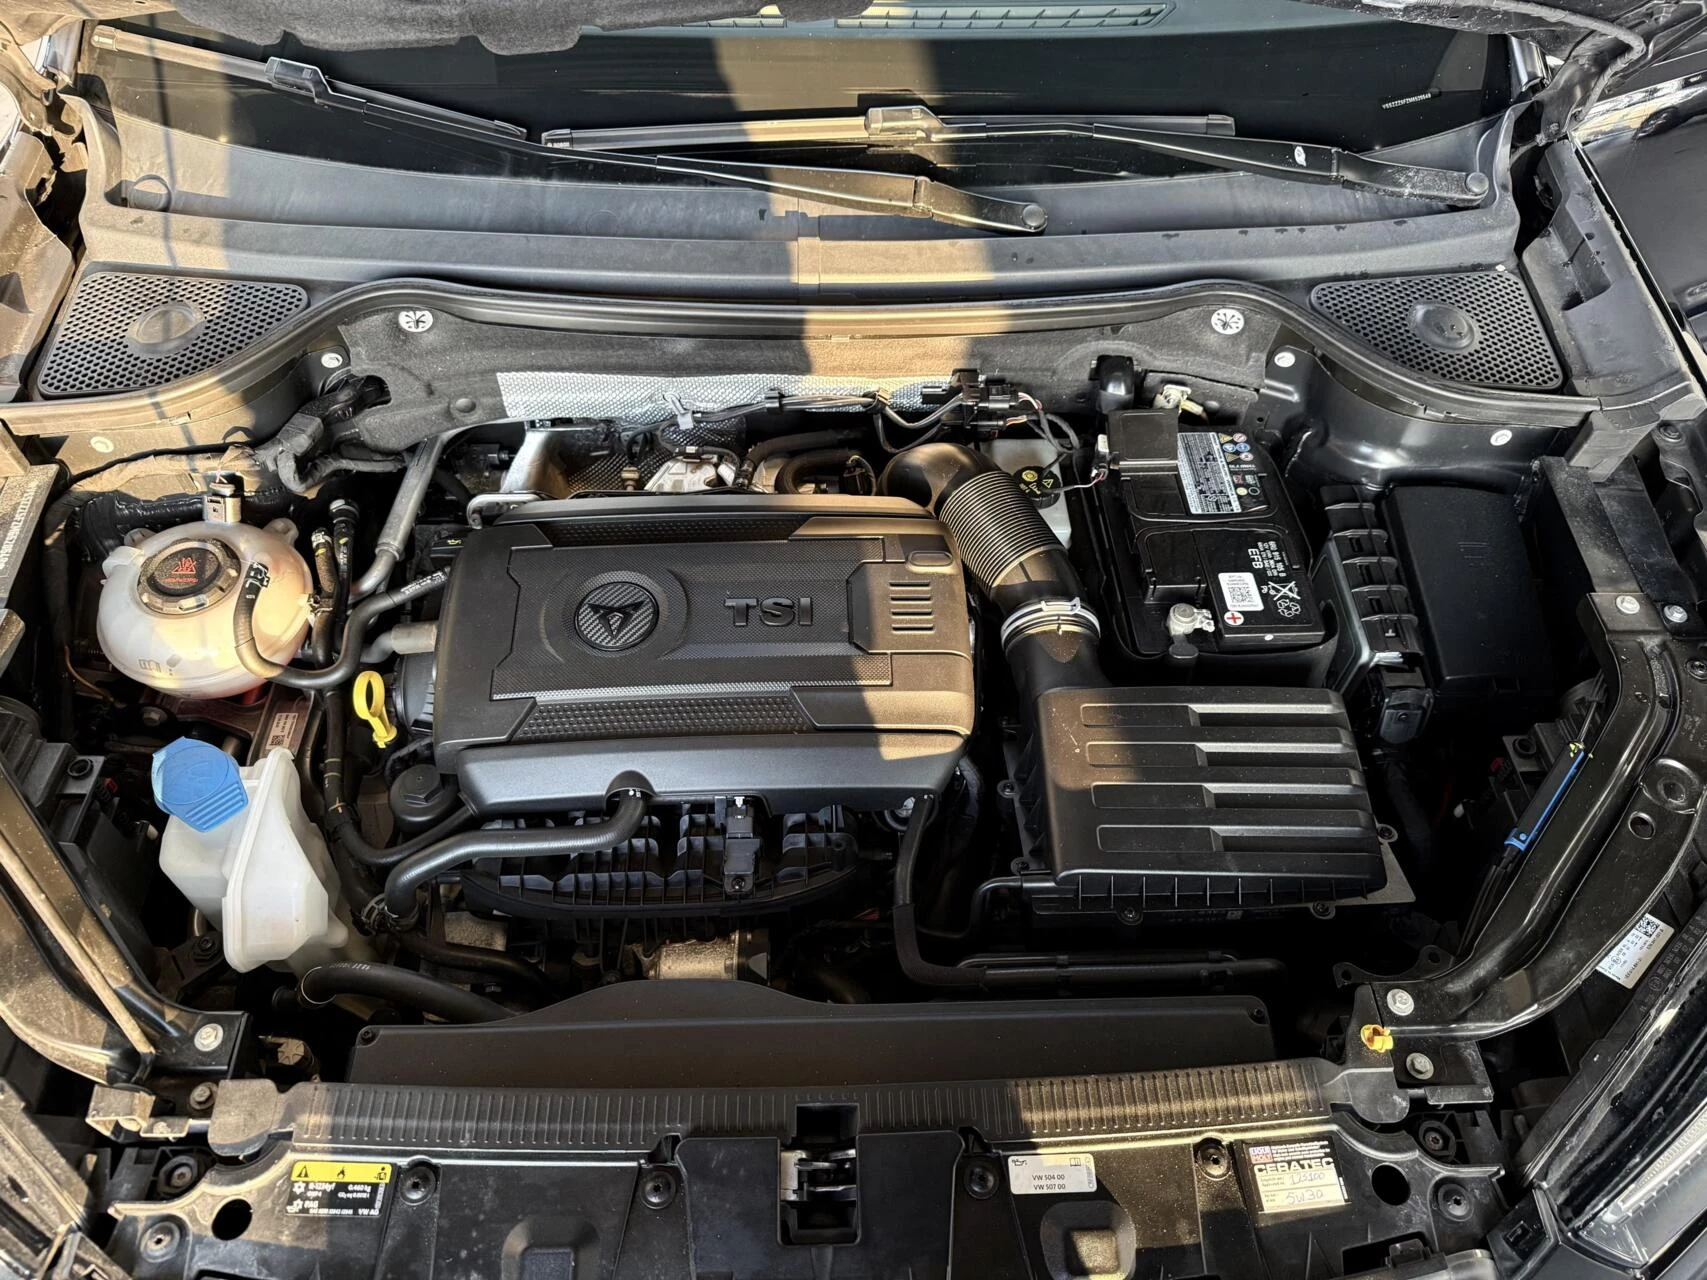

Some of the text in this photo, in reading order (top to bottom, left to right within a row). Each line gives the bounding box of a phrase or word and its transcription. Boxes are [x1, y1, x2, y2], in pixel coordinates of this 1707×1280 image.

[1247, 548, 1264, 568] EFB
[724, 597, 812, 627] TSI
[1254, 1157, 1334, 1174] CERATEC
